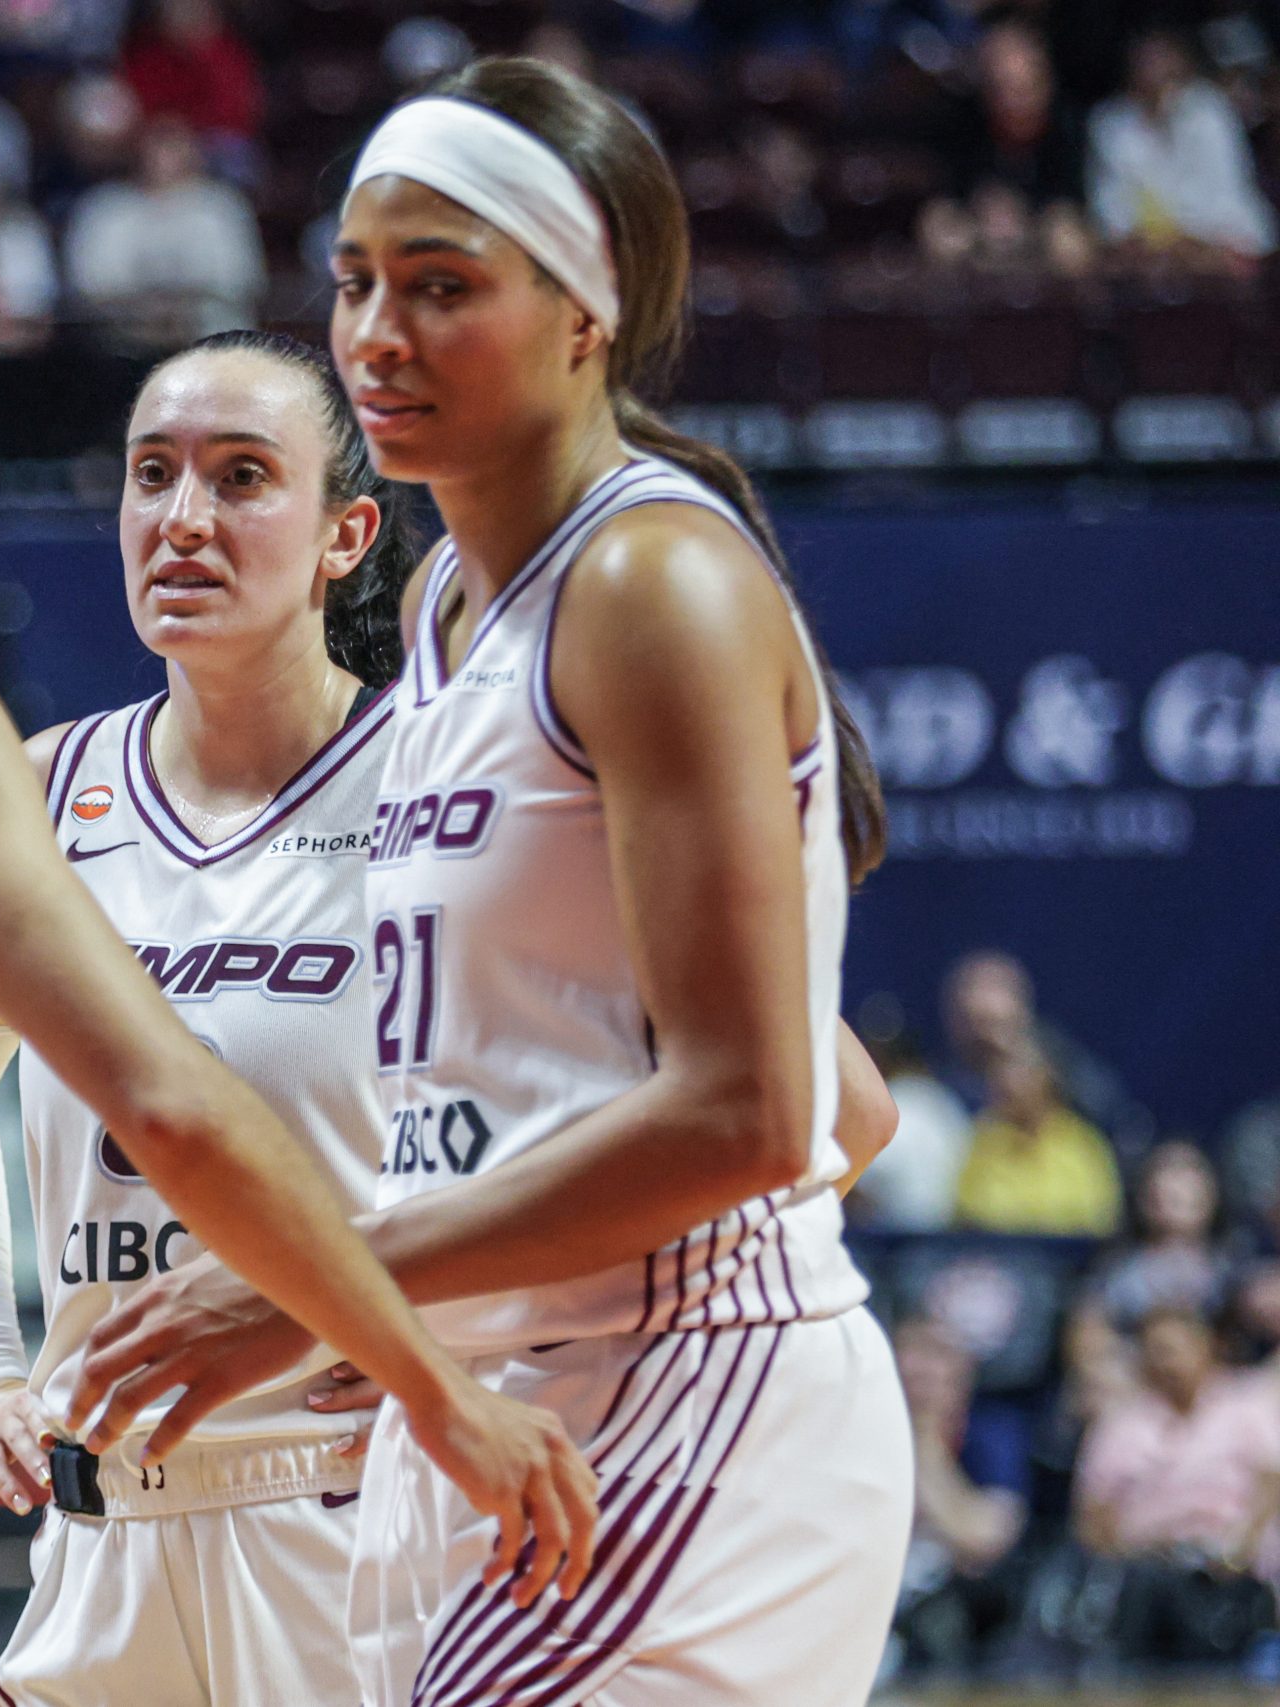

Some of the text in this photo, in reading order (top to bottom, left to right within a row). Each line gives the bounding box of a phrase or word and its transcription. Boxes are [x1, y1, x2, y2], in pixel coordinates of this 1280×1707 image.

[270, 833, 372, 854] SEPHORA
[125, 938, 362, 1001] MPO
[373, 909, 439, 1072] 21
